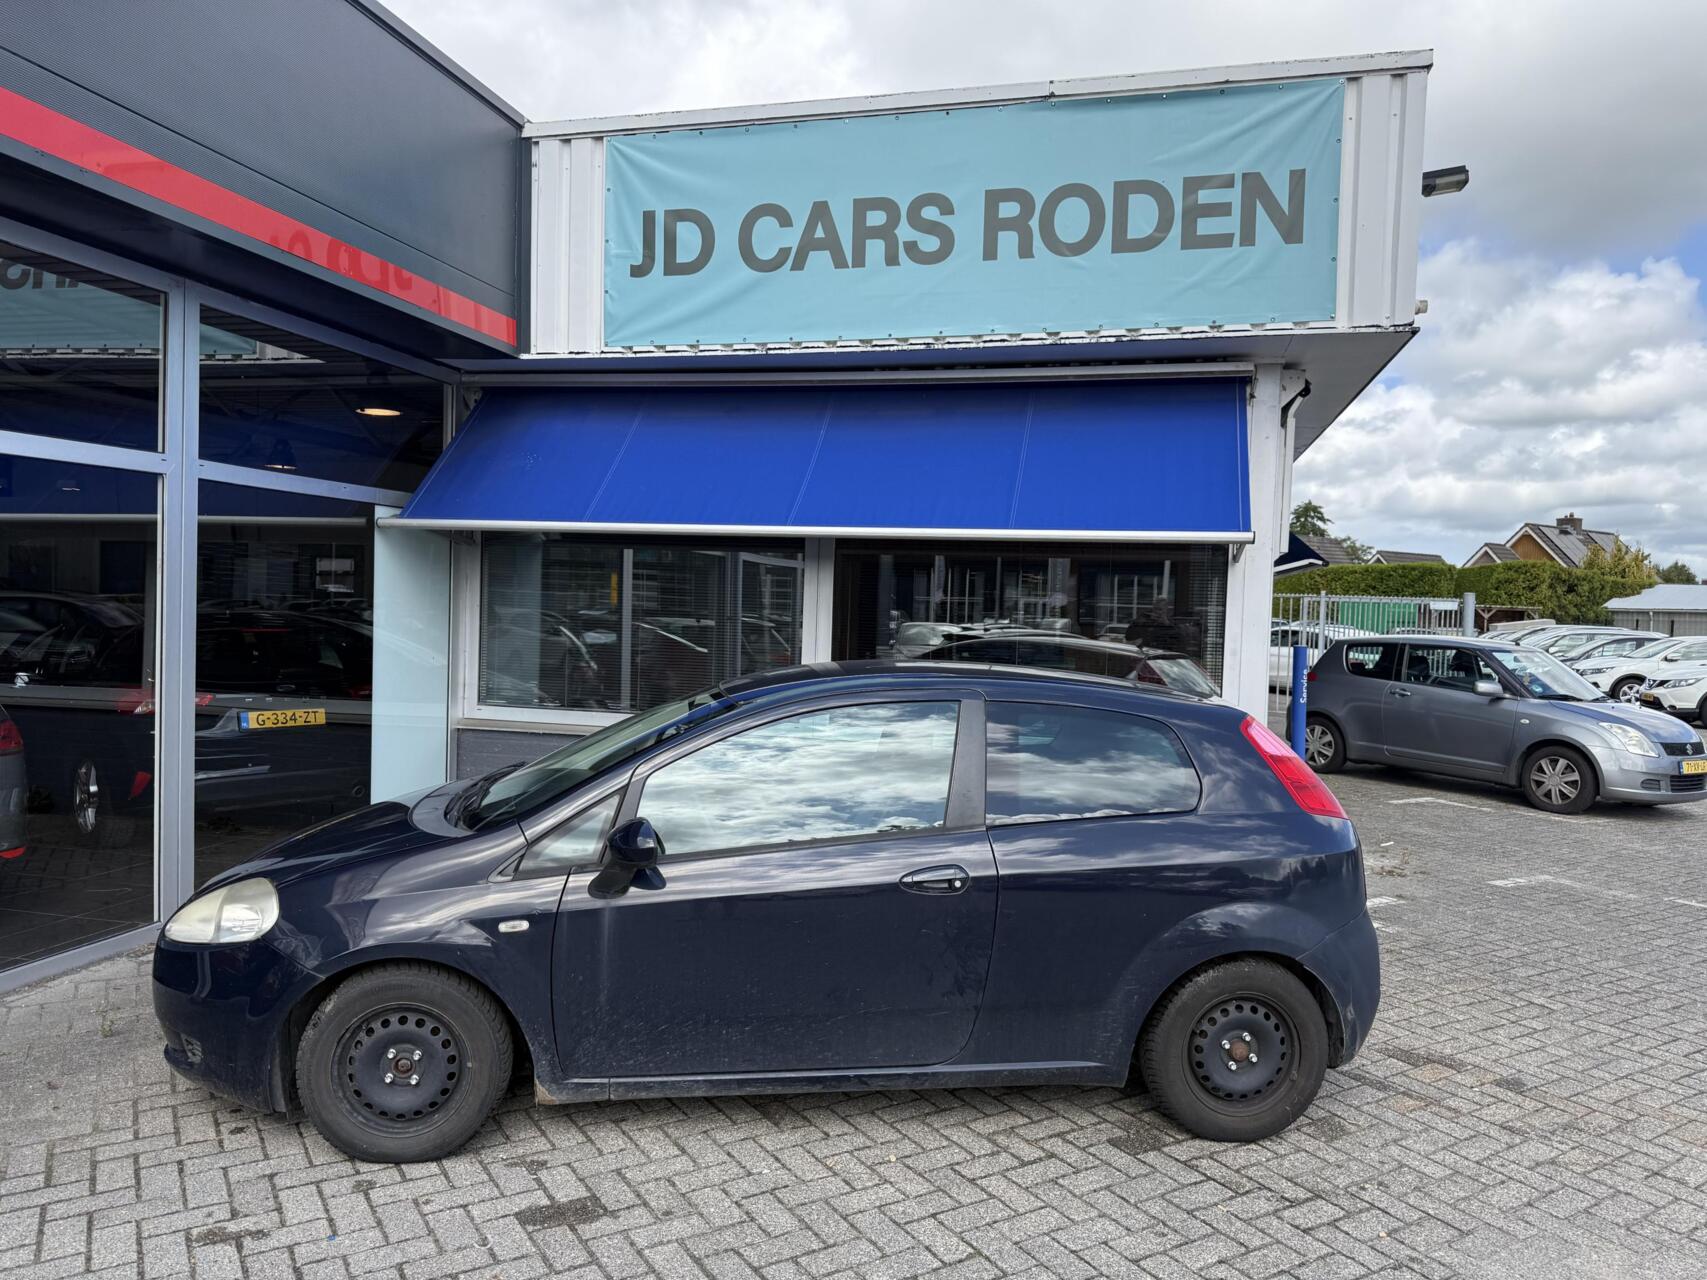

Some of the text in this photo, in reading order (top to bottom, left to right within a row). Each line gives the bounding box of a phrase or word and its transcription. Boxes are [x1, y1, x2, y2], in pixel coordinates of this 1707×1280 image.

[629, 168, 1307, 278] JD CARS RODEN
[256, 710, 319, 726] G-334-ZT
